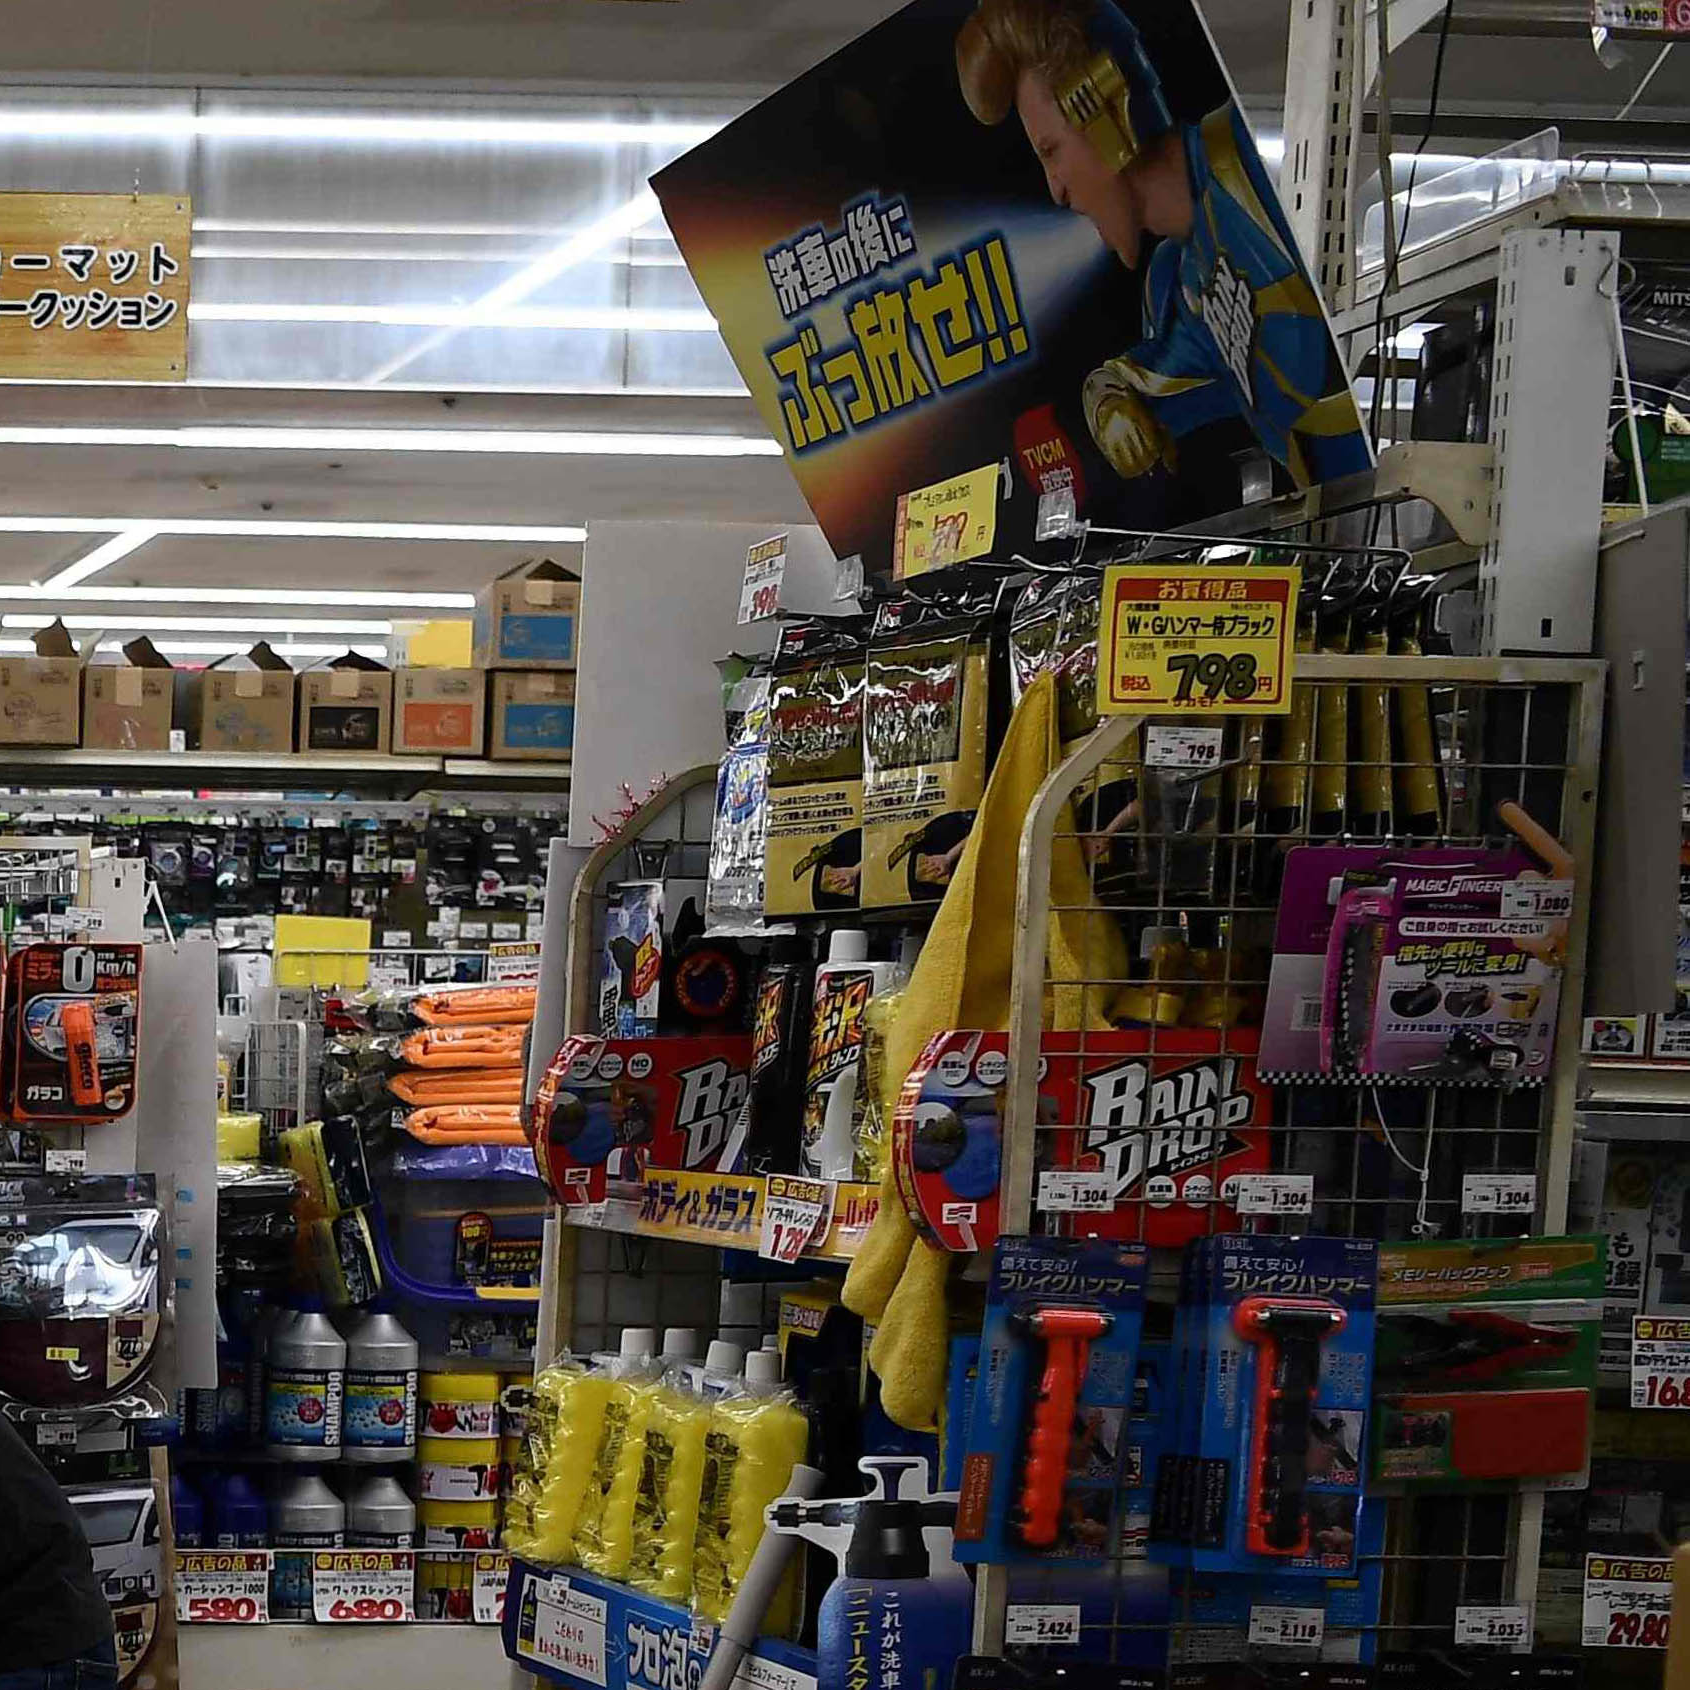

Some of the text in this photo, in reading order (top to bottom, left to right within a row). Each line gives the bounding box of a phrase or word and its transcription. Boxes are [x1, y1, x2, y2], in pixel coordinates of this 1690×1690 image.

[770, 199, 913, 316] 洗車の後に
[1022, 439, 1067, 470] TVCM
[1158, 580, 1248, 599] お買得品
[1166, 653, 1258, 701] 798
[1257, 676, 1273, 691] 円
[1187, 744, 1216, 759] 798
[1404, 875, 1503, 897] MAGIC FINGER
[25, 1084, 64, 1102] ガラコ
[1088, 1056, 1237, 1146] RAIN
[1223, 1256, 1305, 1275] 備えて安心!
[998, 1271, 1142, 1293] ブレイクハンマー
[1222, 1271, 1373, 1295] ブレイクハンマー
[323, 1370, 343, 1447] SHAMPOO
[402, 1370, 419, 1446] SHAMPOO
[185, 1556, 248, 1572] 広告の品
[333, 1555, 395, 1572] 広告の品
[188, 1598, 257, 1621] 580
[328, 1598, 404, 1621] 680
